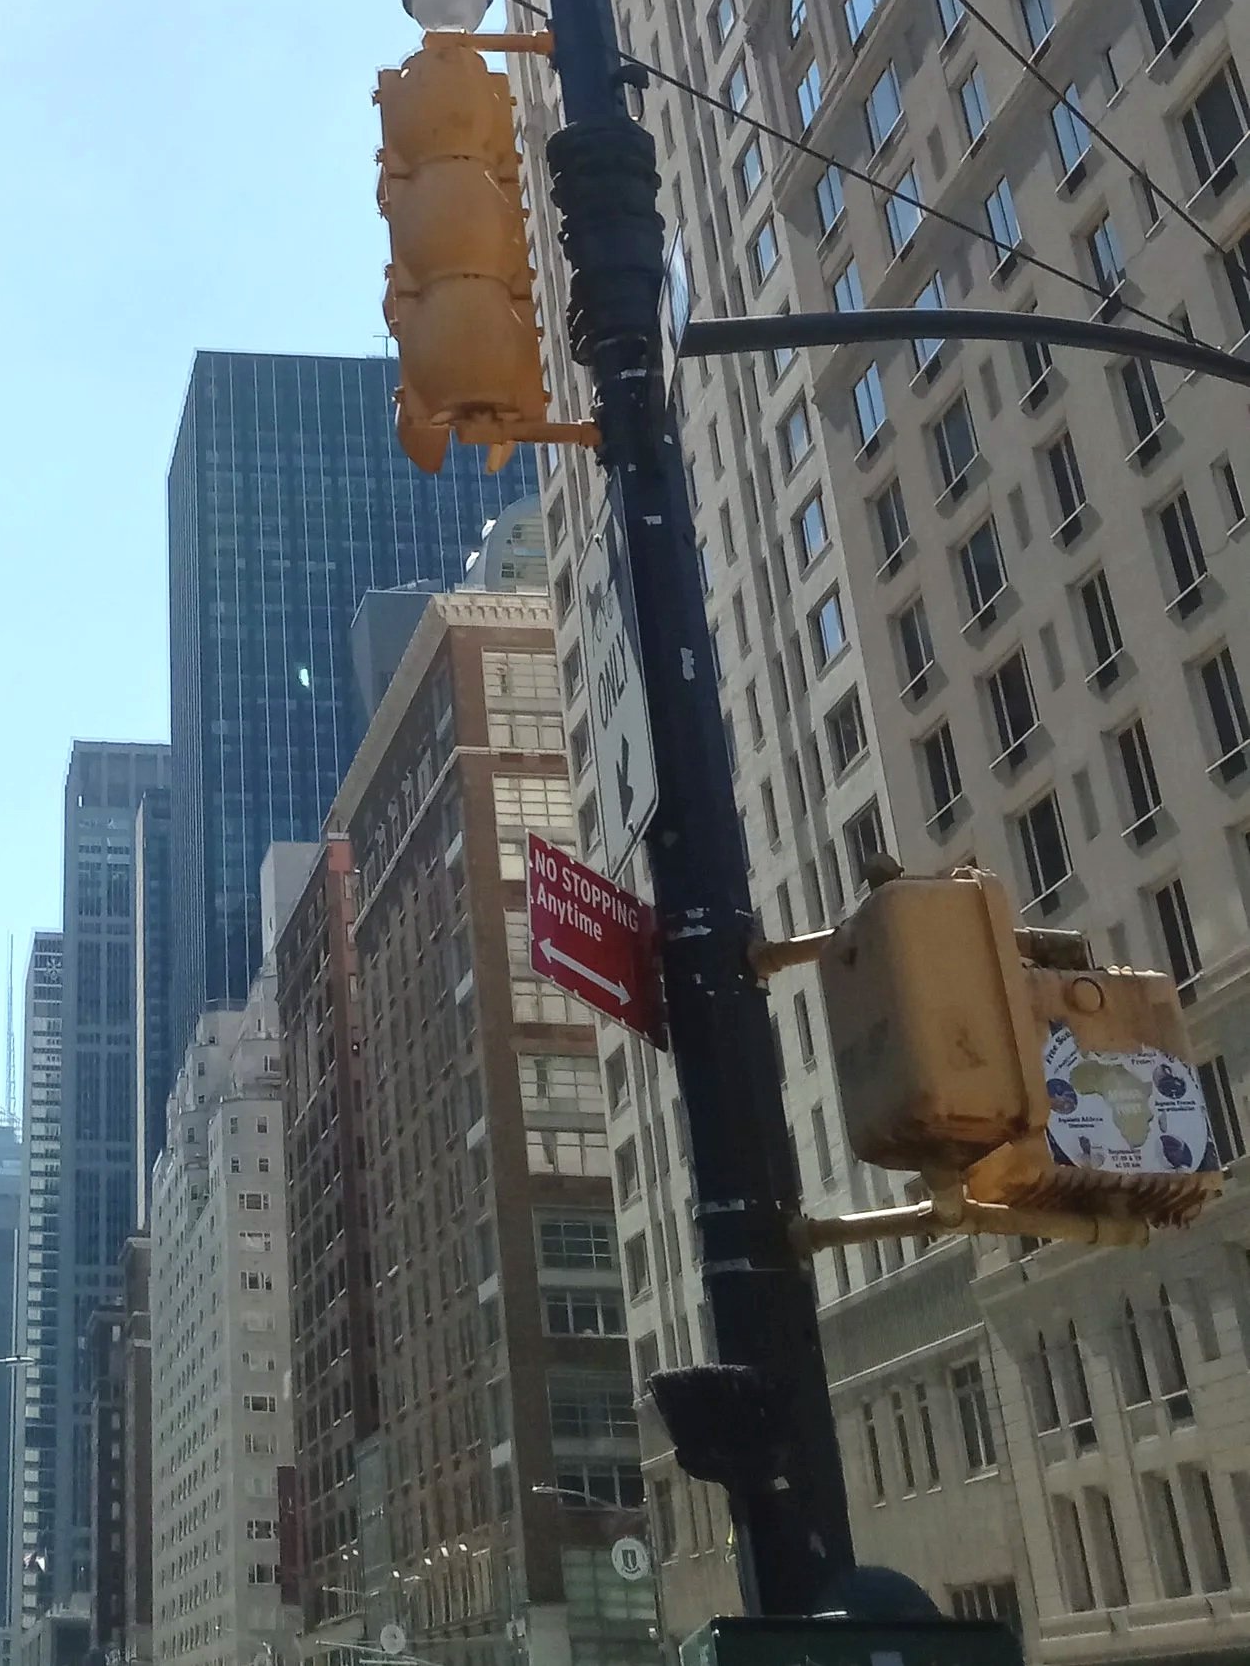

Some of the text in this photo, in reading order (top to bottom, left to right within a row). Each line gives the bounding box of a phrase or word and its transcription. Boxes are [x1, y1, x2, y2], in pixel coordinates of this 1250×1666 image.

[599, 632, 628, 731] ONLY
[535, 848, 639, 933] NO STOPPING
[536, 882, 603, 942] Anytime
